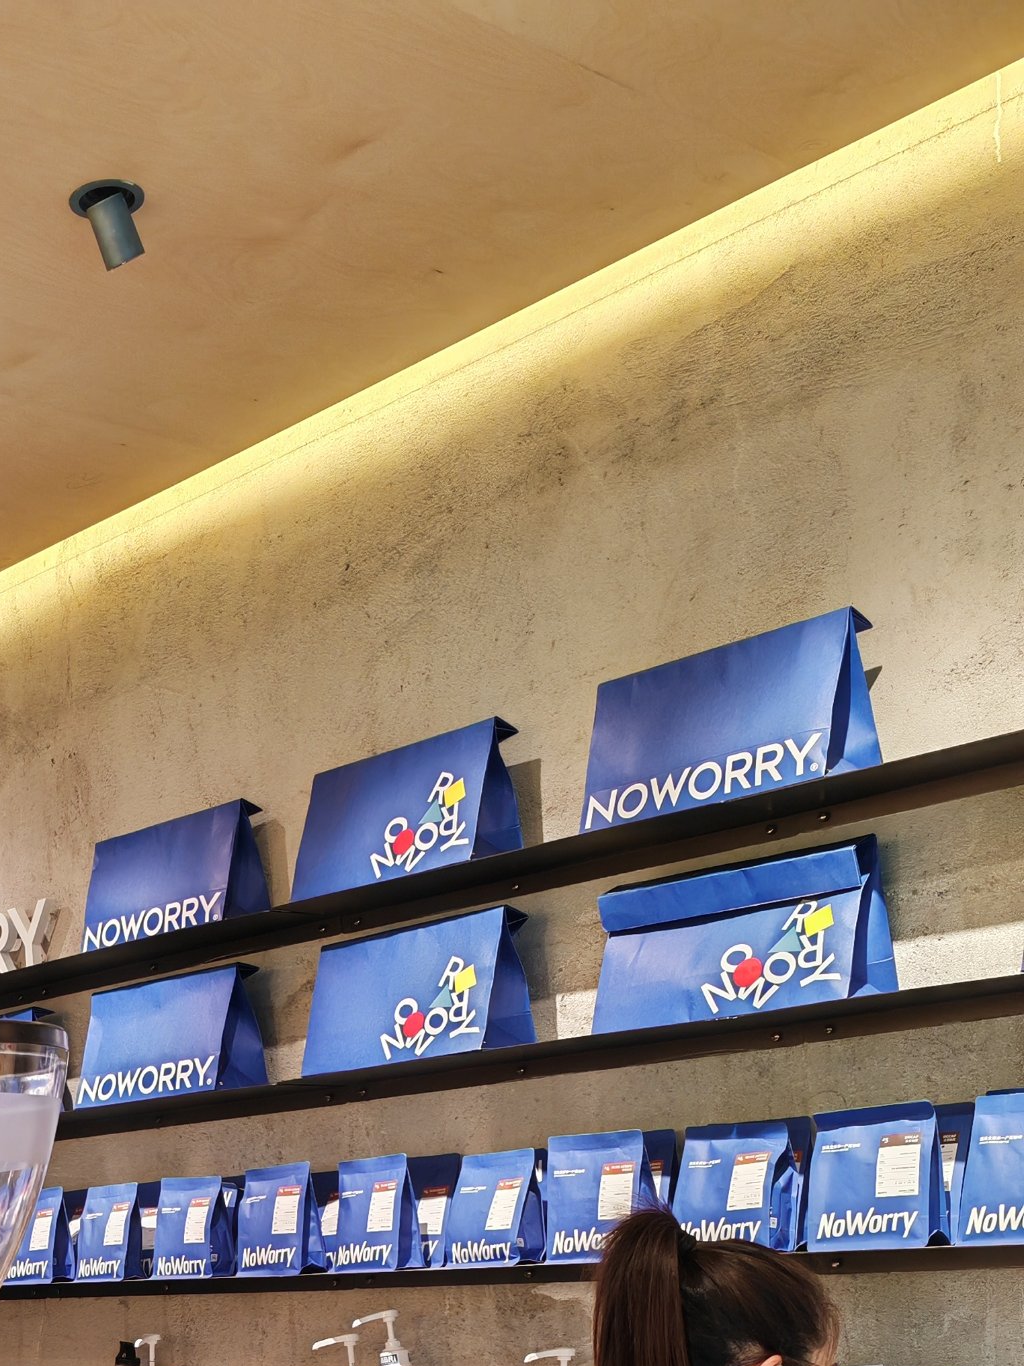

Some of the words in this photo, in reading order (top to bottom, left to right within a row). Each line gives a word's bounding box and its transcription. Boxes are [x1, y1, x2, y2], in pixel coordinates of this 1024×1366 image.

[816, 1207, 919, 1240] NoWorry
[241, 1243, 297, 1268] NoWorry
[336, 1240, 393, 1266] NoWorry
[451, 1238, 511, 1265] NoWorry
[78, 1255, 121, 1278] NoWorry
[157, 1255, 207, 1277] NoWorry
